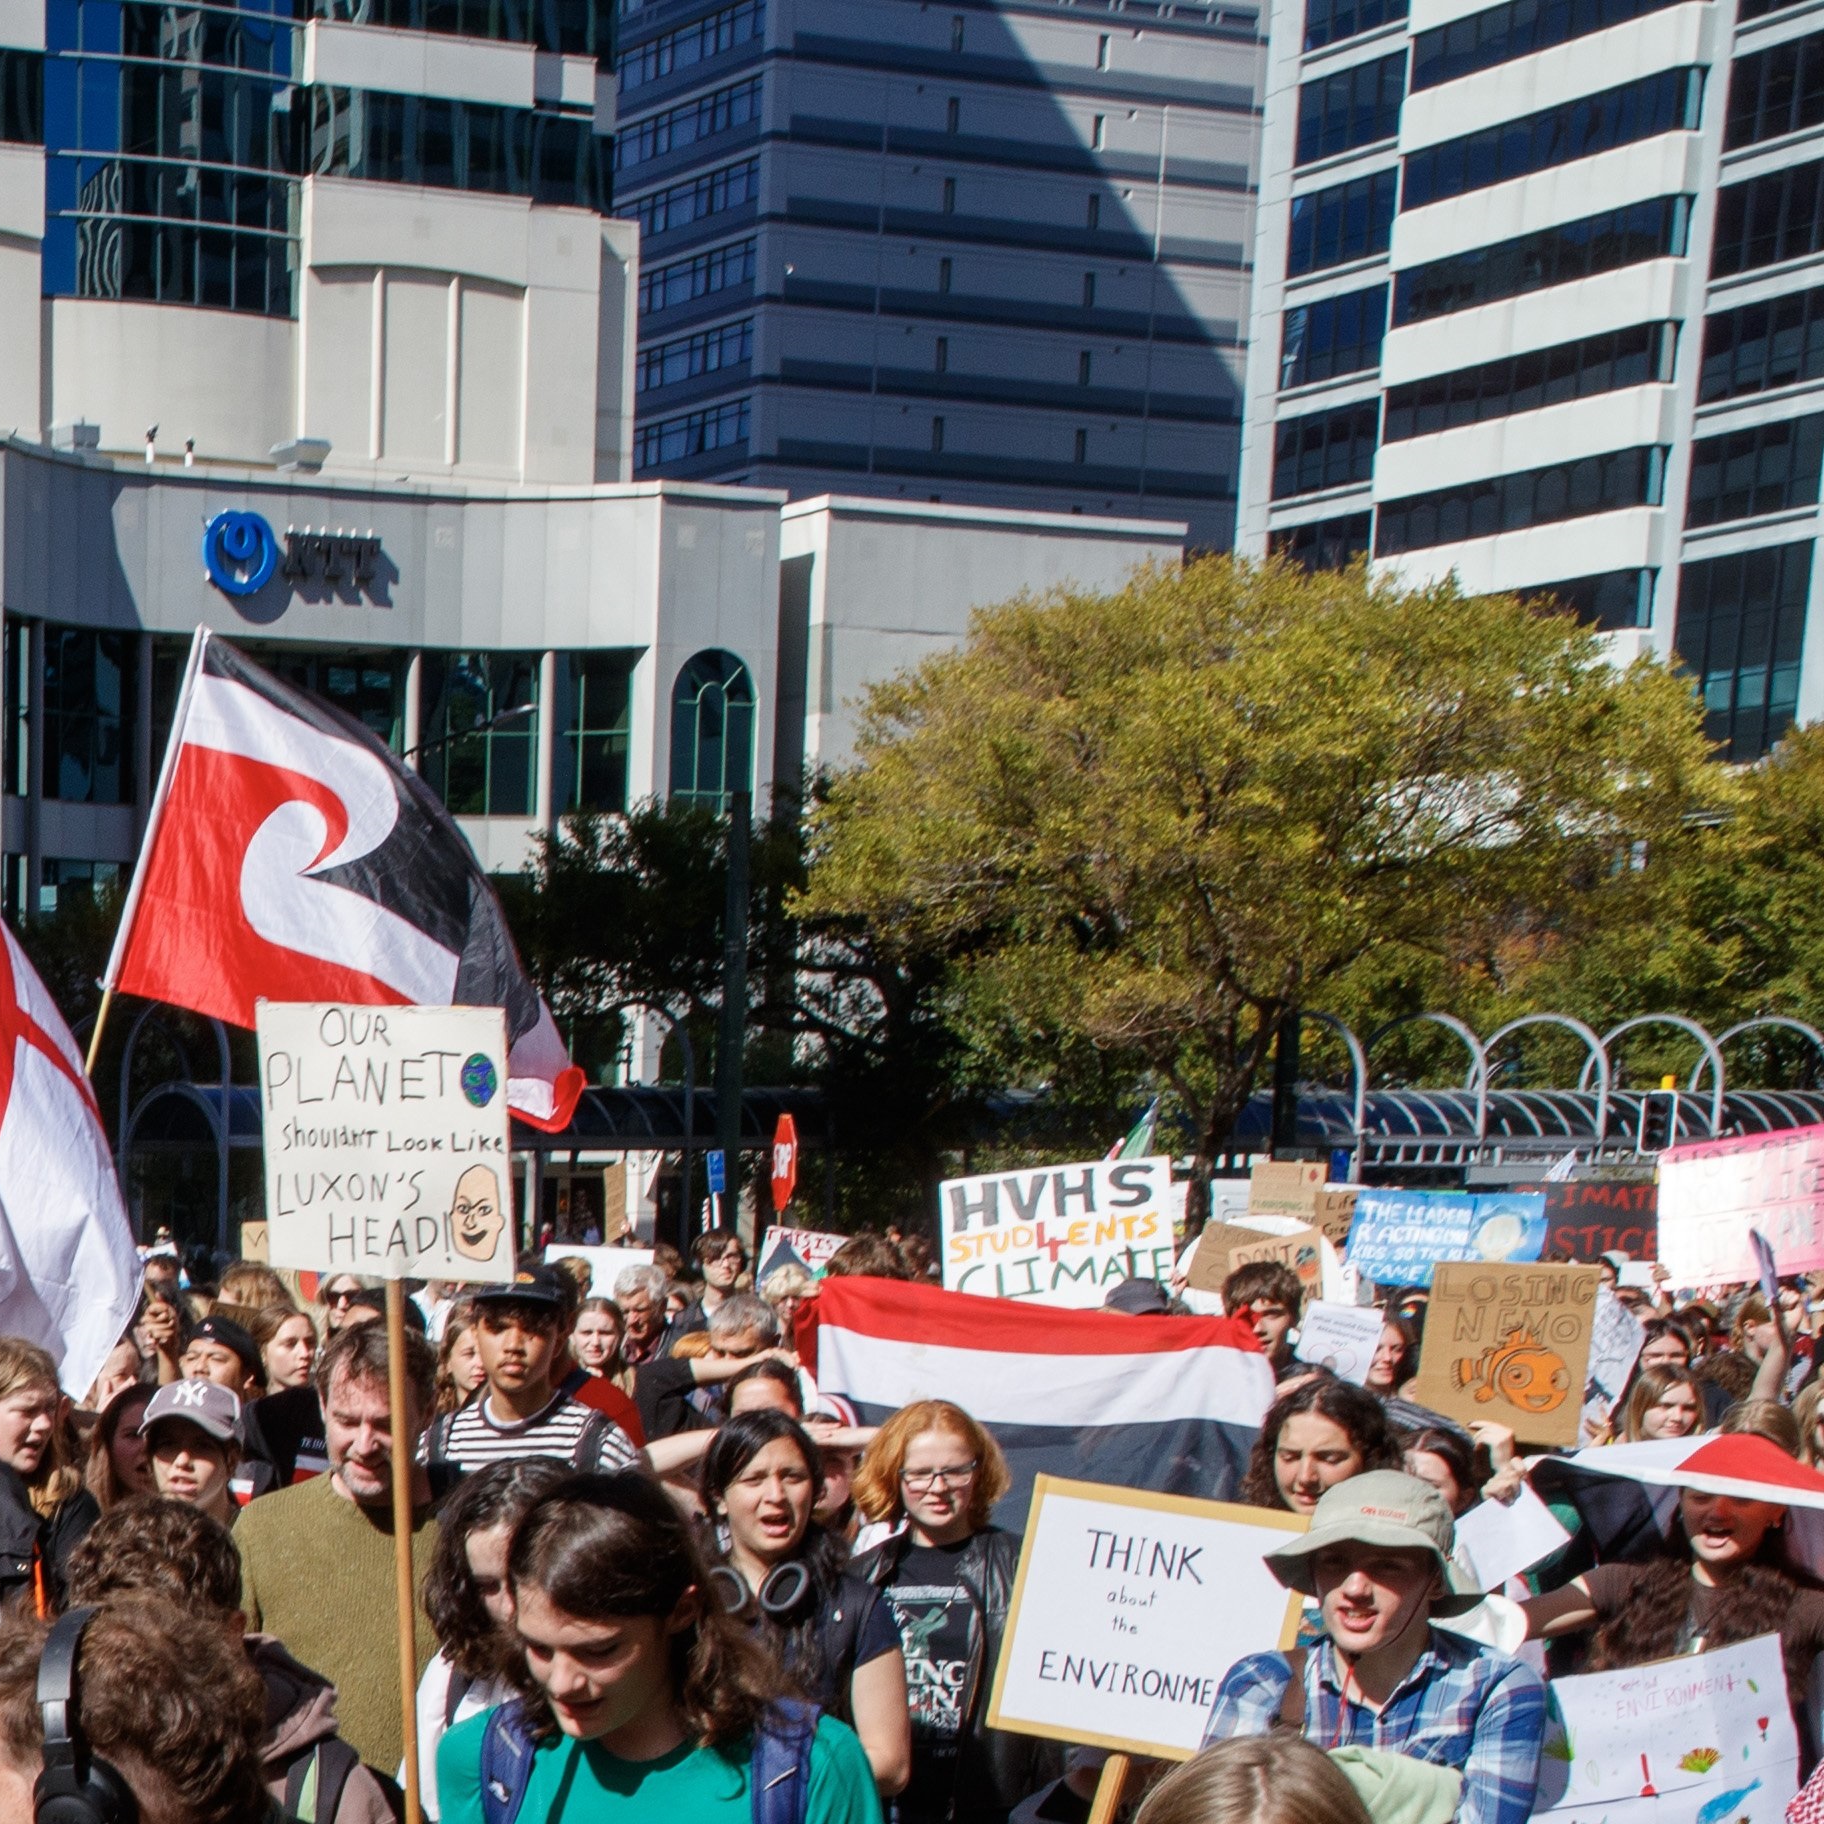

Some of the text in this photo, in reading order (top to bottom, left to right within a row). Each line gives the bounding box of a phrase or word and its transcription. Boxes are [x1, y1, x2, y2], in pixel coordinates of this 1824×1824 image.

[285, 532, 381, 580] NTT
[319, 1007, 391, 1047] OUR
[266, 1051, 462, 1111] PLANET
[277, 1170, 425, 1216] LUXON'S
[950, 1164, 1154, 1232] HVHS
[1362, 1199, 1405, 1224] THE
[329, 1211, 453, 1263] HEAD!
[1435, 1267, 1598, 1308] LOSING
[1453, 1304, 1582, 1345] NEMO
[172, 1379, 208, 1408] NY
[1087, 1528, 1205, 1585] THINK
[1107, 1584, 1159, 1609] about
[1112, 1614, 1139, 1636] the
[1038, 1650, 1214, 1709] ENVIRONME
